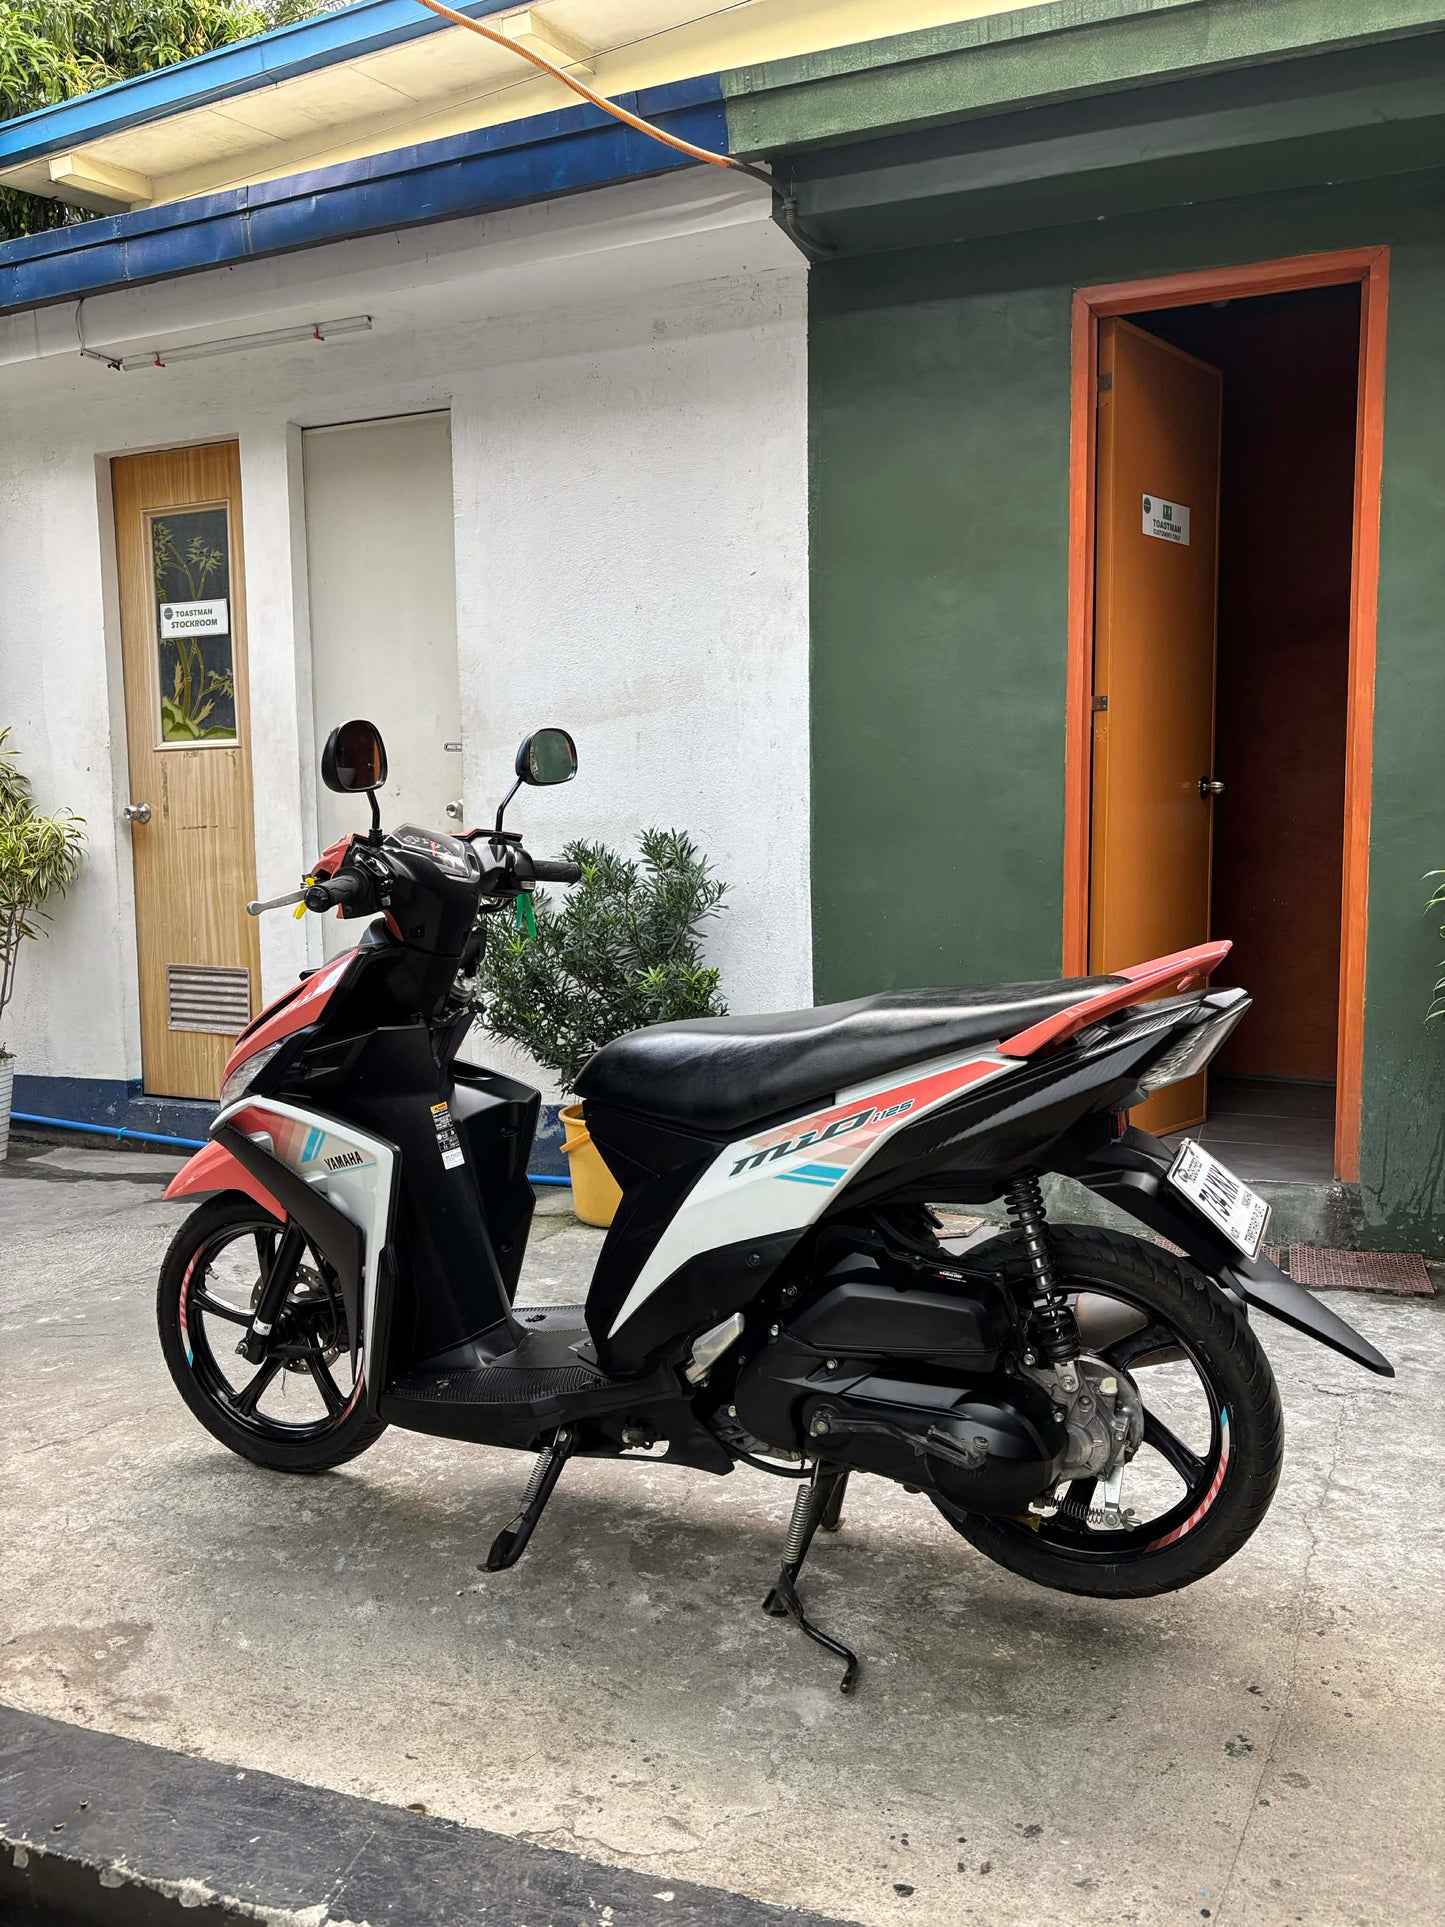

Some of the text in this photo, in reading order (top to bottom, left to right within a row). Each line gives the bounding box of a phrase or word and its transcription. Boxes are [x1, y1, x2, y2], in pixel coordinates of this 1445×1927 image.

[1153, 519, 1182, 534] TOASTMAN
[175, 608, 213, 618] TOASTMAN
[171, 618, 218, 629] STOCKROOM
[324, 1151, 364, 1171] YAMAHA
[1198, 1183, 1232, 1223] 734
